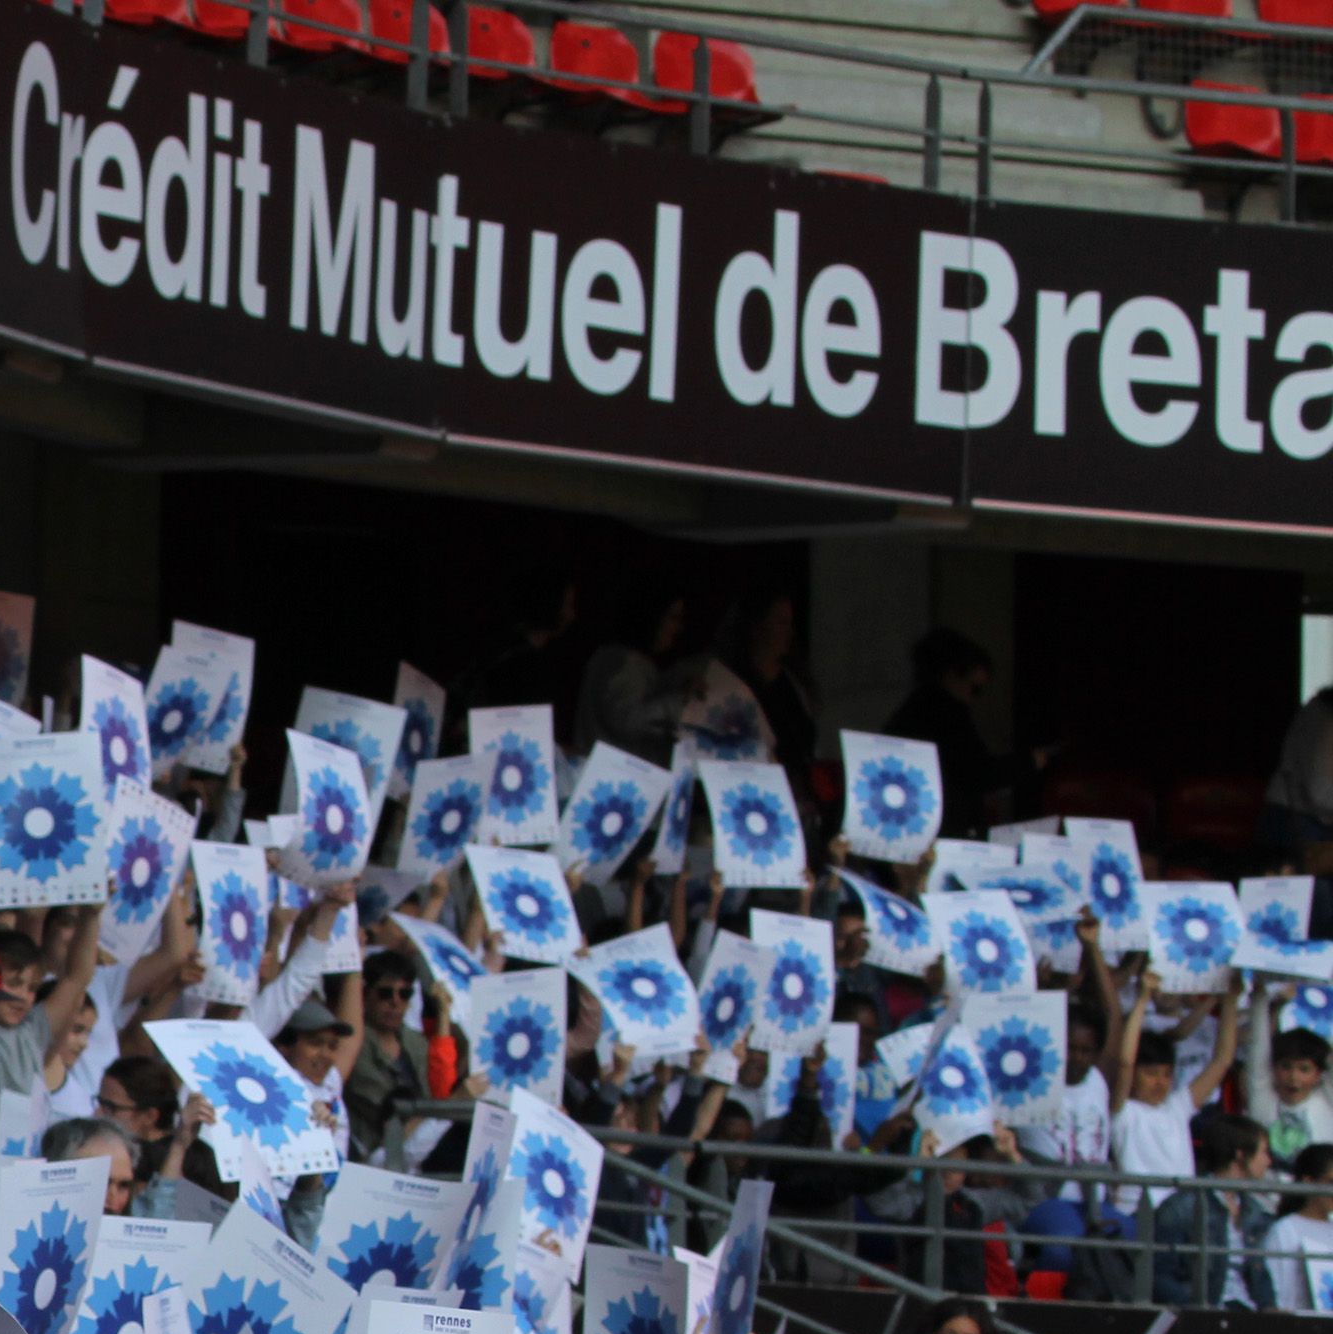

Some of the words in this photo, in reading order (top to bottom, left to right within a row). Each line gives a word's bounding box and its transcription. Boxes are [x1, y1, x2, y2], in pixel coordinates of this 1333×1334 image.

[11, 40, 270, 318] Crédit
[289, 123, 682, 402] Mutuel
[715, 208, 883, 419] de
[435, 1313, 471, 1328] rennes
